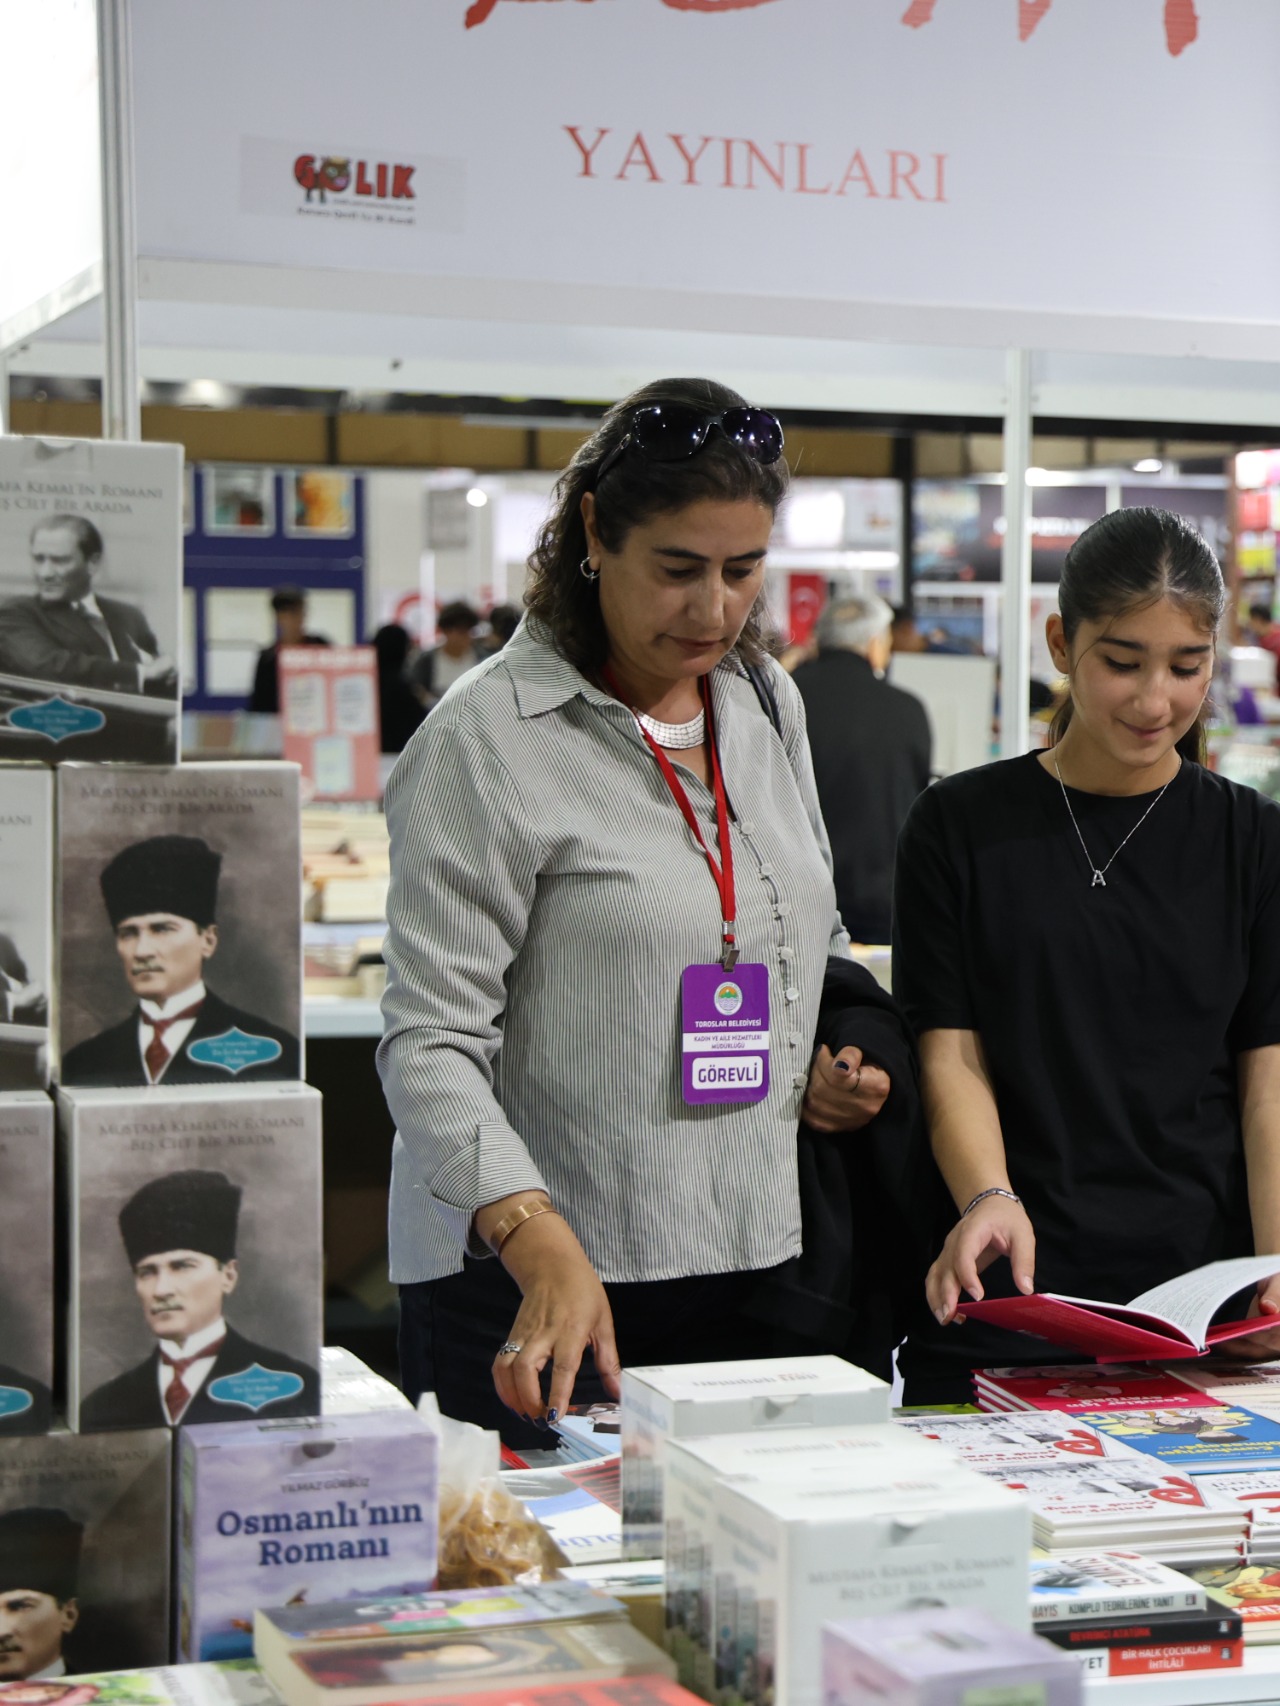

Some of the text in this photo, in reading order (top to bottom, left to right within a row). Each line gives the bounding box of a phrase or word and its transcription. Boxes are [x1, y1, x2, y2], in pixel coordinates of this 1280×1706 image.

[561, 124, 950, 203] YAYINLARI
[694, 1017, 762, 1028] TOROSLAR BELEDİYESİ
[698, 1062, 758, 1083] GÖREVLİ
[280, 1481, 322, 1493] YILMAZ
[216, 1499, 424, 1538] Osmanlı'nın
[258, 1537, 390, 1567] Romanı
[1069, 1601, 1100, 1615] KOMPLO
[1152, 1595, 1175, 1608] YANIT
[1121, 1648, 1137, 1661] BİR
[1138, 1647, 1162, 1660] HALK
[1163, 1644, 1212, 1658] ÇOCUKLARI
